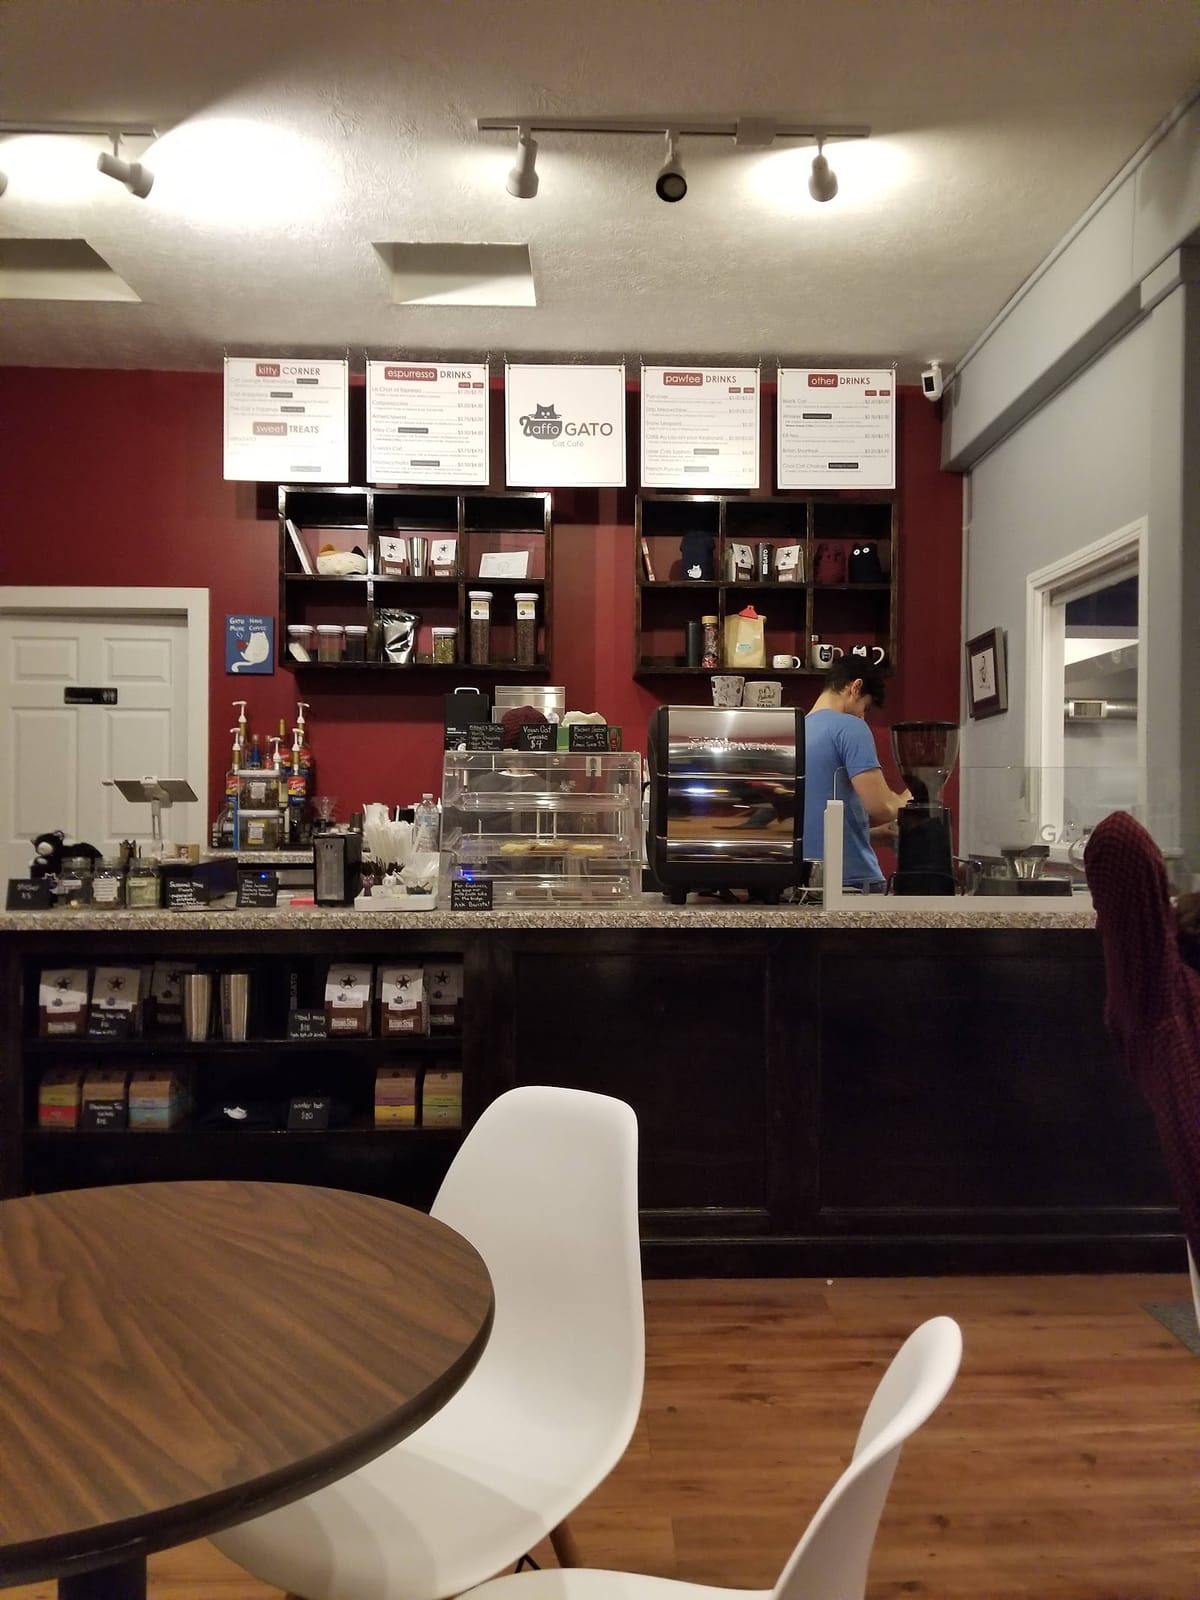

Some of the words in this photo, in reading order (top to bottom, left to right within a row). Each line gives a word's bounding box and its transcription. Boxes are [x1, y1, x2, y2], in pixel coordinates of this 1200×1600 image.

[257, 365, 278, 376] kitty
[282, 366, 321, 376] CORNER
[387, 369, 435, 380] espurresso
[440, 370, 472, 379] DRINKS
[705, 375, 737, 384] DRINKS
[811, 377, 836, 386] other
[839, 377, 871, 385] DRINKS
[256, 424, 284, 433] sweet
[289, 425, 319, 434] TREATS
[532, 423, 560, 435] affo
[565, 422, 613, 436] GATO
[552, 440, 565, 448] Cat
